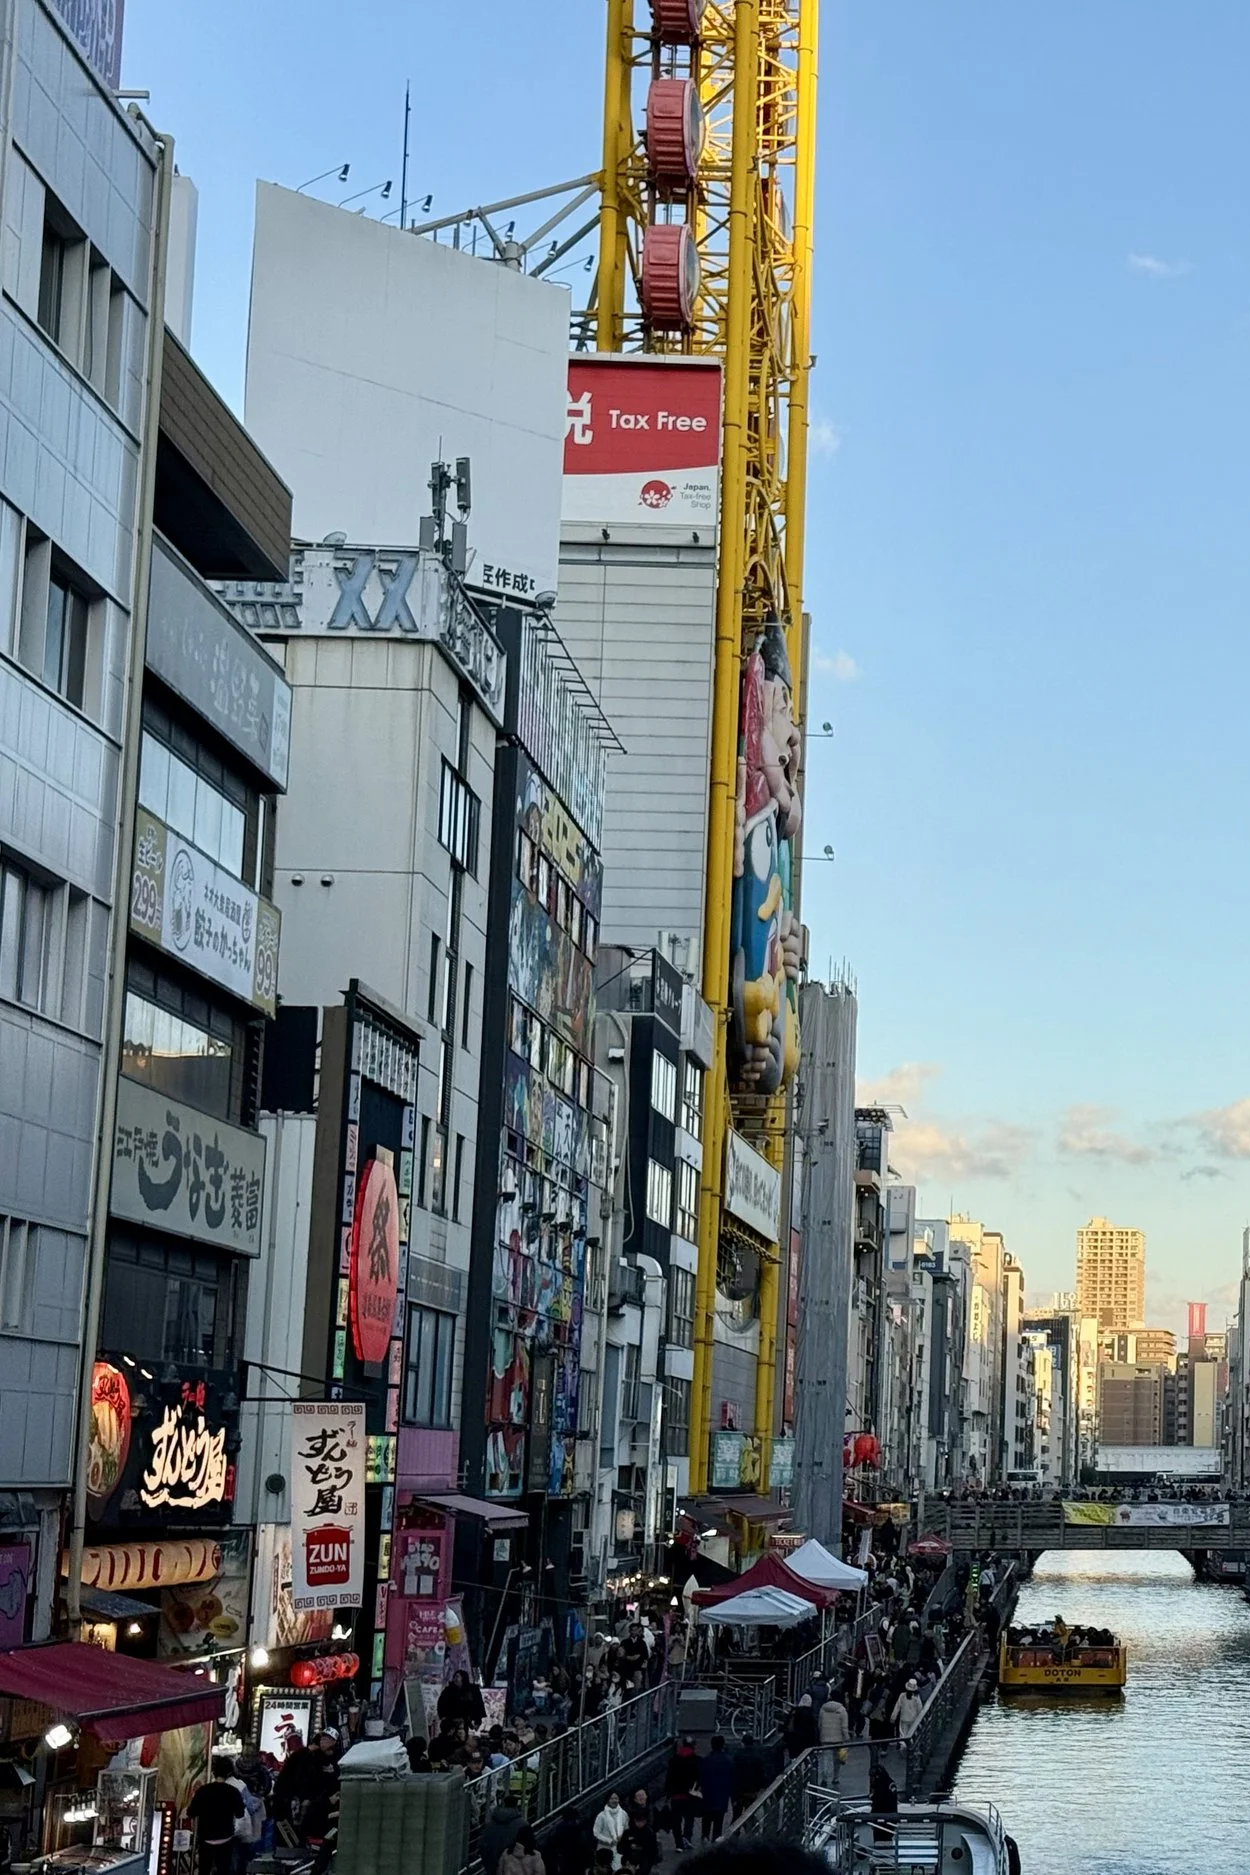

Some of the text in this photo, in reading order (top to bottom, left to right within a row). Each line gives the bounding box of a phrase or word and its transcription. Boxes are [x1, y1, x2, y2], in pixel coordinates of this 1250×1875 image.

[608, 410, 708, 432] Tax Free
[690, 500, 712, 510] Shop
[132, 870, 157, 927] 299
[194, 906, 251, 973] 餃子のかっちゃん
[309, 1543, 347, 1563] ZUN
[309, 1565, 347, 1575] ZUNDO-YA
[1044, 1669, 1082, 1677] DOTON
